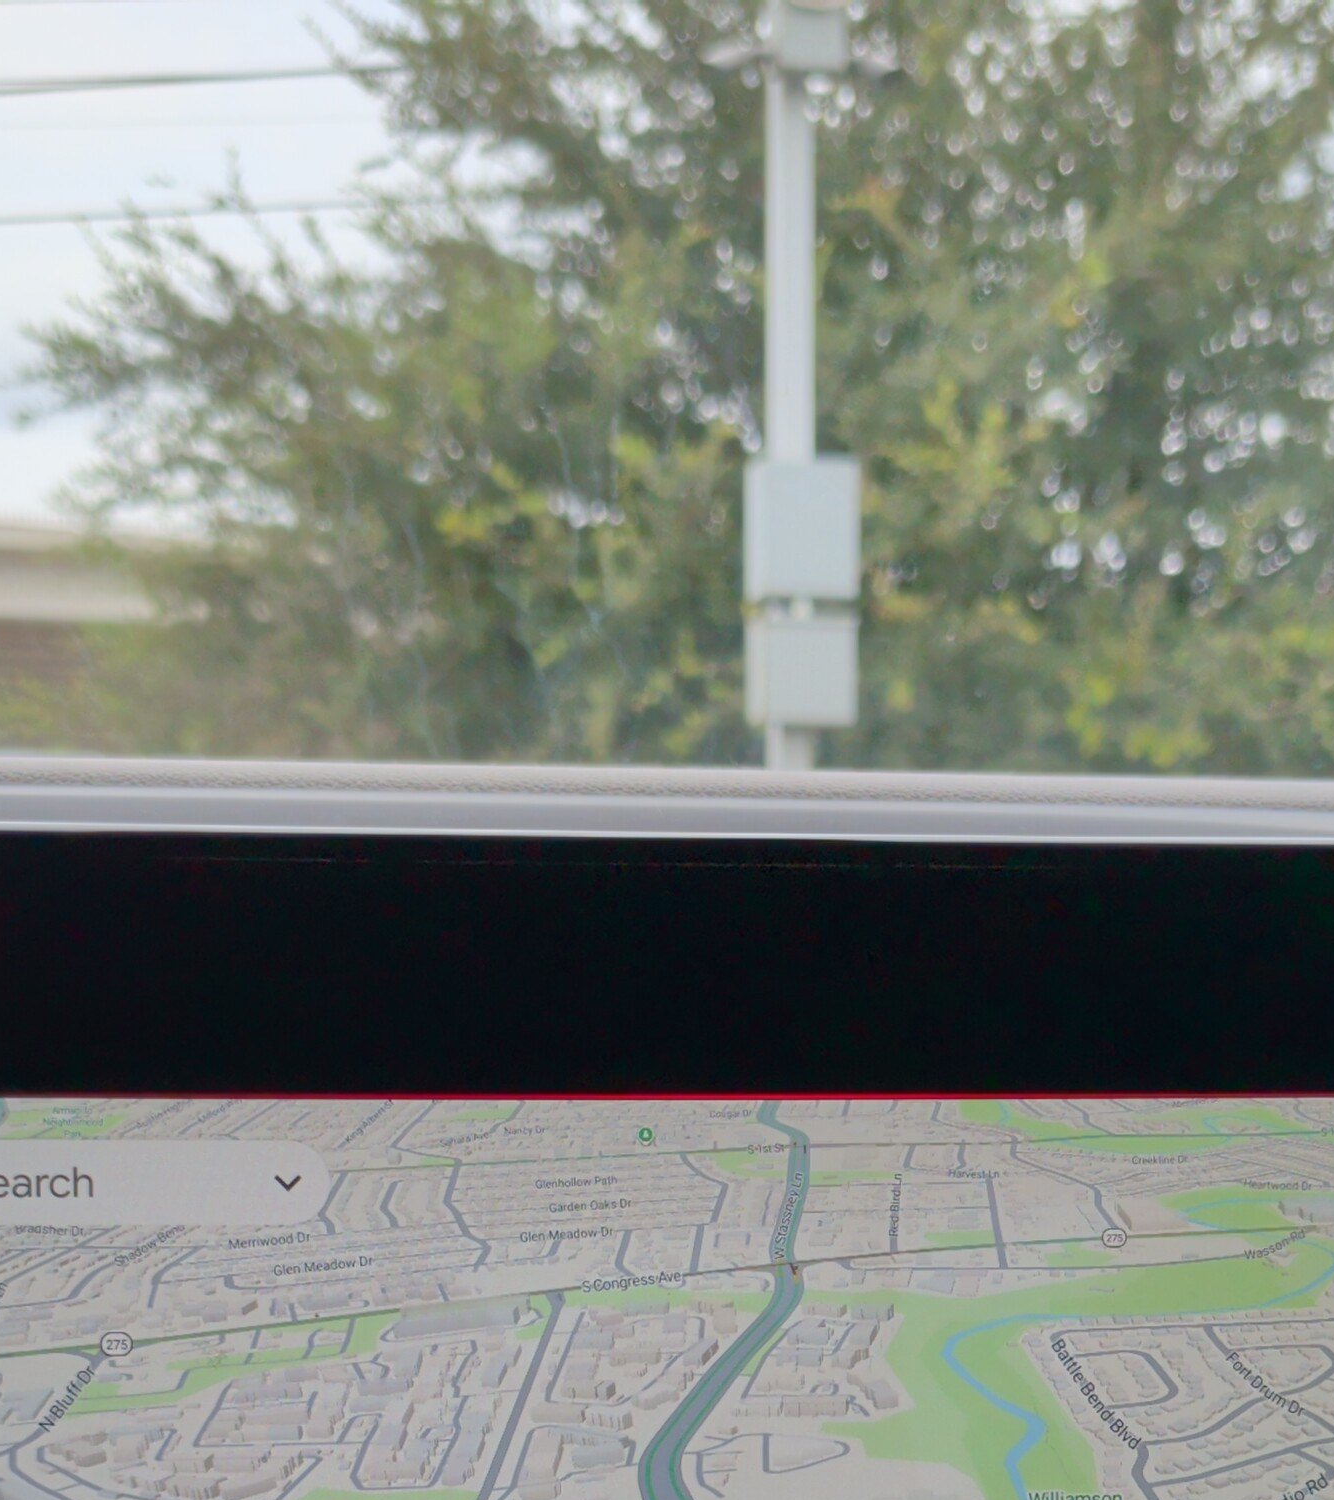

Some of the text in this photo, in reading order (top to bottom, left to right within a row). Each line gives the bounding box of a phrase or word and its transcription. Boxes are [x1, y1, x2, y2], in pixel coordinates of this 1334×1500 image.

[1131, 1154, 1188, 1165] Creekline Dr
[535, 1175, 618, 1190] Glenhollow Path
[948, 1168, 986, 1180] Harvest
[1243, 1178, 1312, 1191] Heartwood Dr
[549, 1198, 632, 1214] Garden Oaks Dr
[775, 1172, 804, 1260] W Stassney Ln
[889, 1172, 903, 1238] Red Bird Ln
[228, 1231, 311, 1251] Merriwood Dr
[520, 1226, 614, 1243] Glen Meadow Dr
[1106, 1233, 1124, 1244] 275
[1244, 1228, 1307, 1260] Wasson Rd
[114, 1239, 156, 1267] Shadow
[273, 1255, 373, 1277] Glen Meadow Dr
[581, 1271, 682, 1293] S Congress Ave
[105, 1338, 129, 1352] 275
[1051, 1338, 1142, 1451] Battle Bend Blvd
[1226, 1351, 1306, 1418] Fort Drum Dr
[37, 1365, 97, 1433] N Bluff Dr
[1305, 1472, 1329, 1496] Rd
